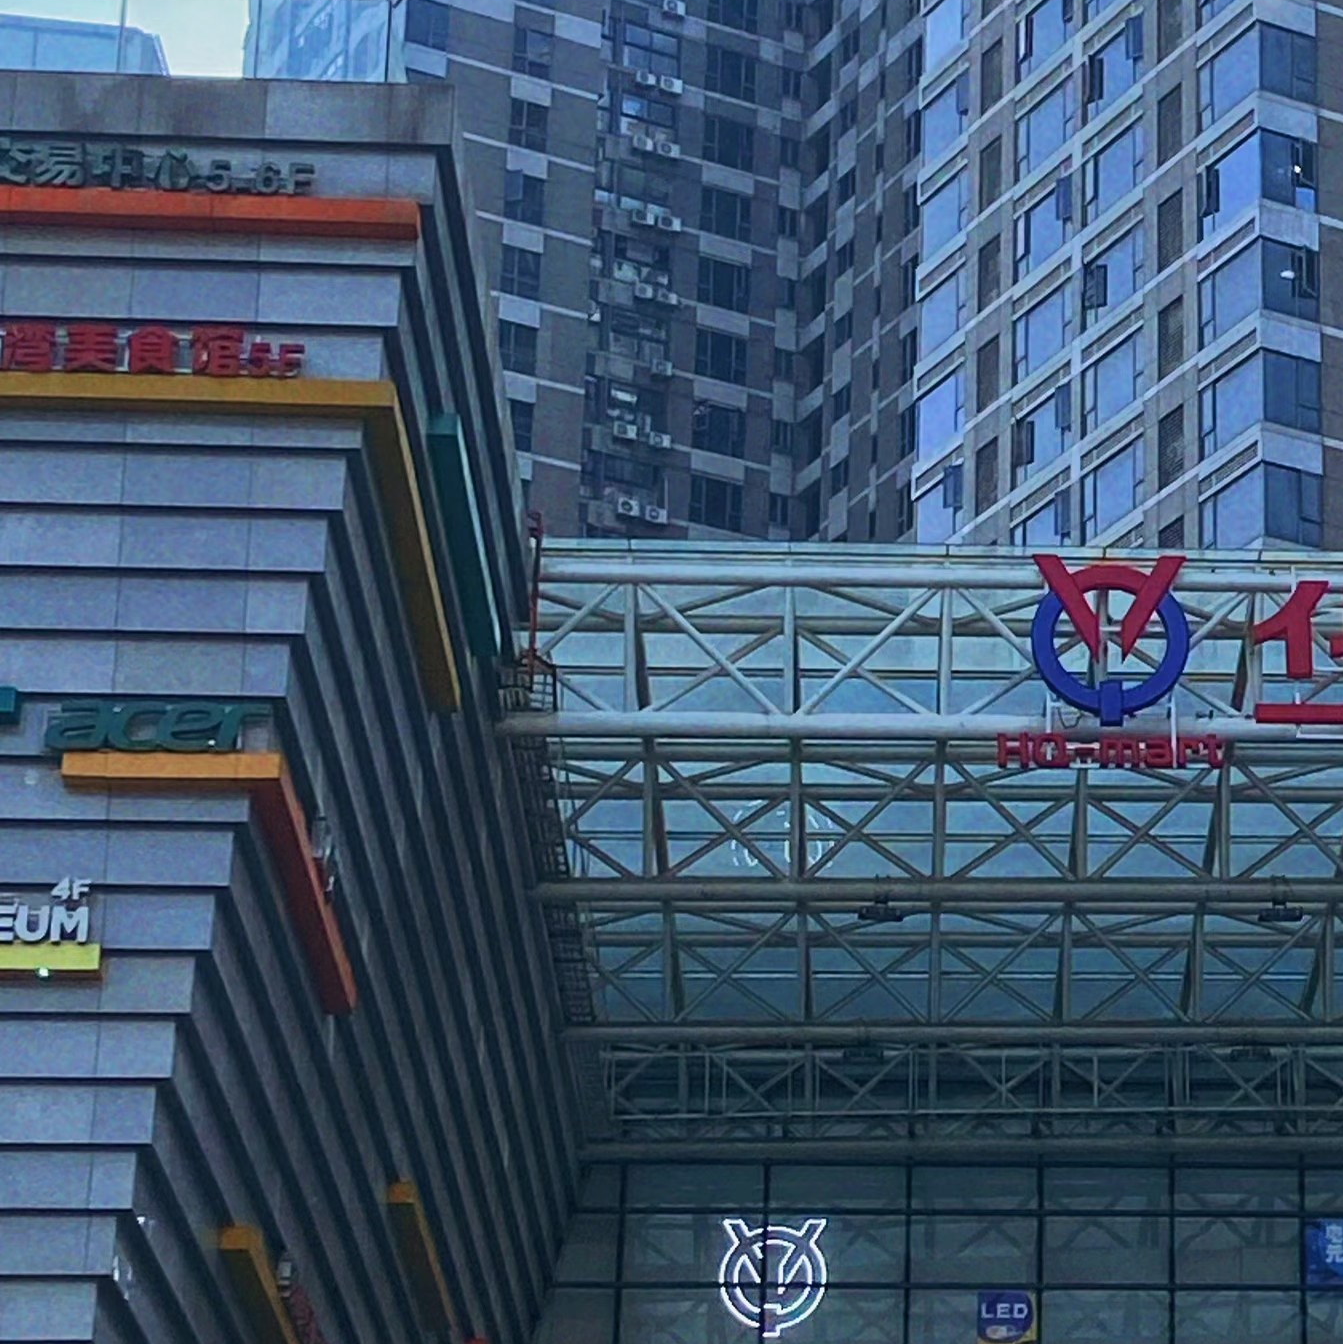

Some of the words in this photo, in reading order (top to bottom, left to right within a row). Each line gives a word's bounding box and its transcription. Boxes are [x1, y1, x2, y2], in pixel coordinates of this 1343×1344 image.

[44, 698, 272, 753] acer
[51, 878, 91, 901] 4F
[980, 1302, 1029, 1321] LED
